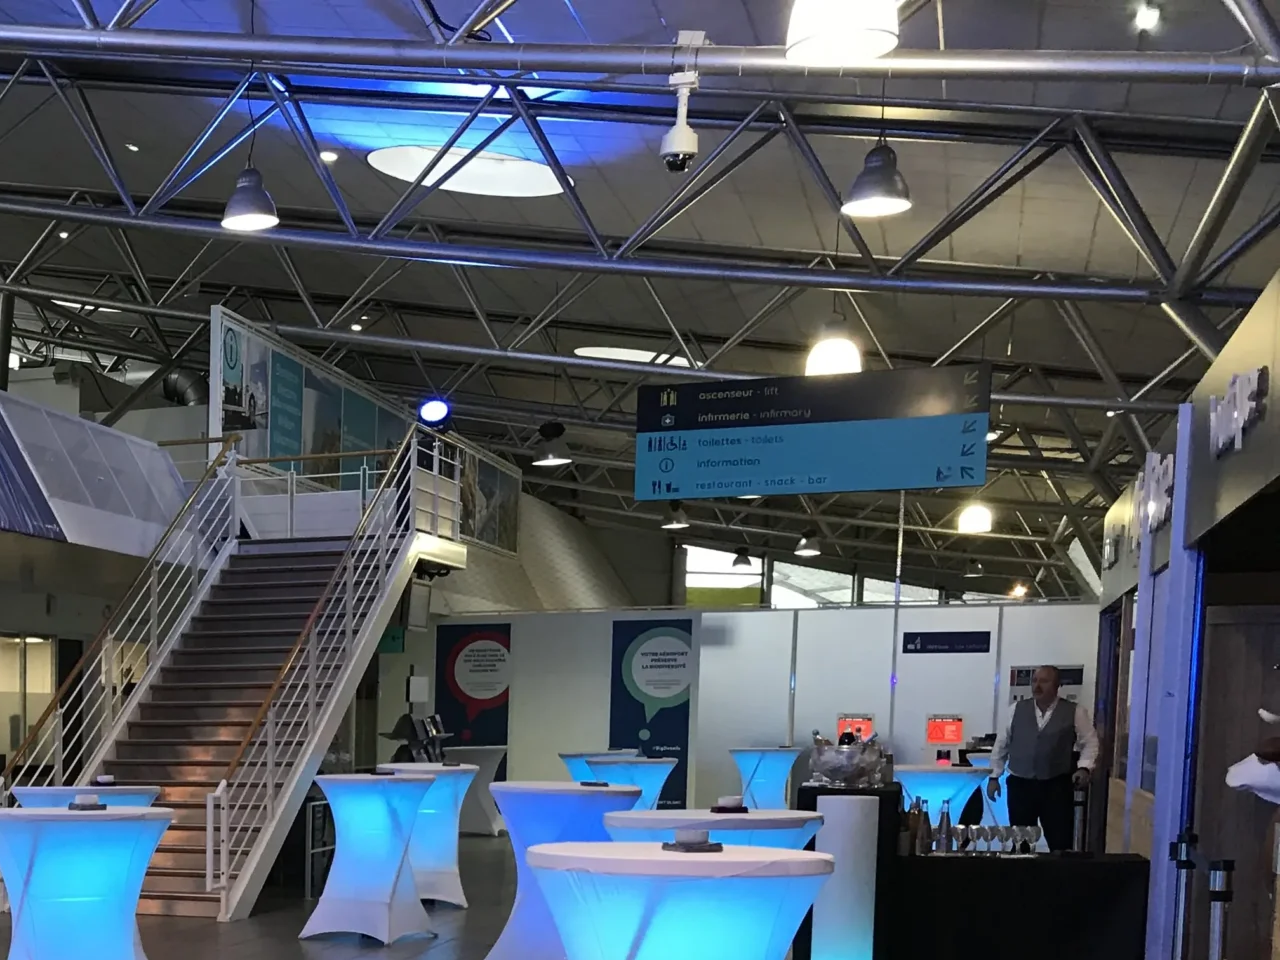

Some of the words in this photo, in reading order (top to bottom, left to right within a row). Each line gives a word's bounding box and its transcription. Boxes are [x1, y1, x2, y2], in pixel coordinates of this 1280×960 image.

[698, 389, 754, 400] ascenseur
[764, 386, 780, 396] lift
[698, 411, 750, 422] infirmerie
[760, 408, 812, 419] infirmary
[697, 437, 742, 447] toilettes
[751, 434, 784, 445] toilets
[696, 457, 761, 468] information
[695, 479, 752, 490] restaurant
[764, 477, 796, 487] snack
[807, 475, 827, 485] bar
